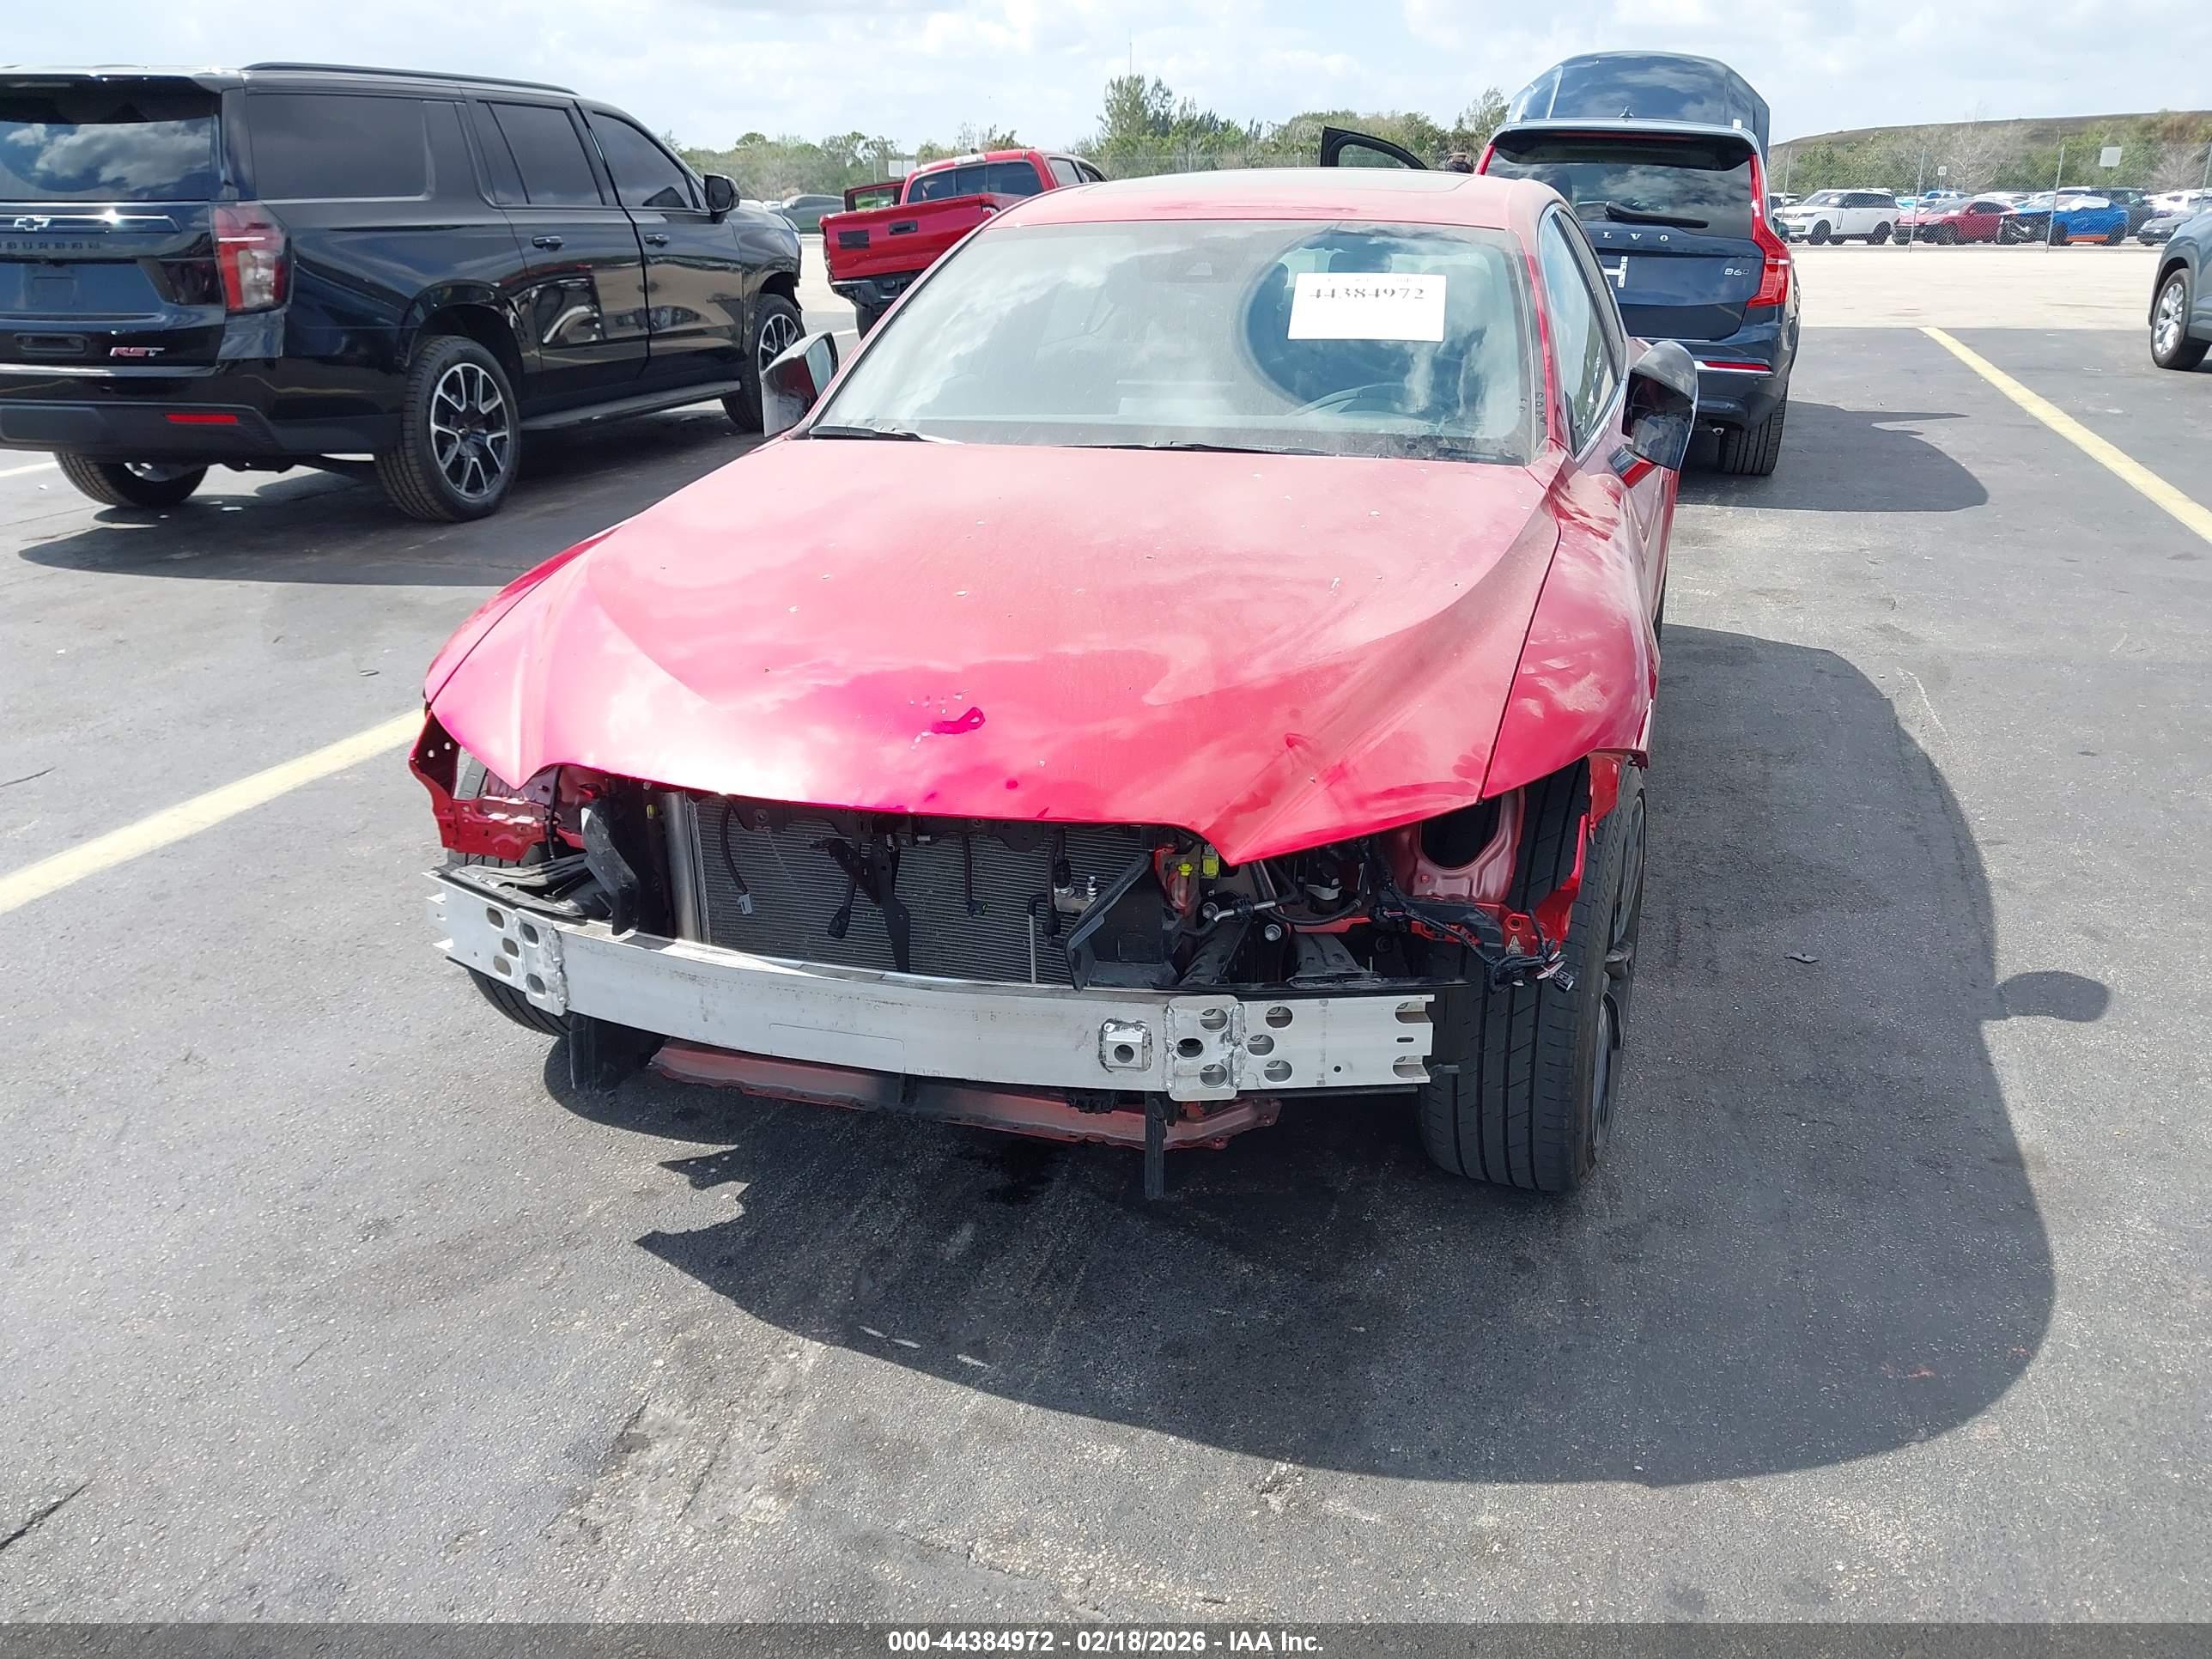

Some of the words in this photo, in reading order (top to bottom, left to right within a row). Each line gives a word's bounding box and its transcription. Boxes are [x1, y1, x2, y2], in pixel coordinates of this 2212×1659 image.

[1602, 231, 1669, 242] LVO
[0, 241, 101, 250] BURBAN
[1308, 287, 1425, 300] 44384972
[109, 346, 166, 358] RST
